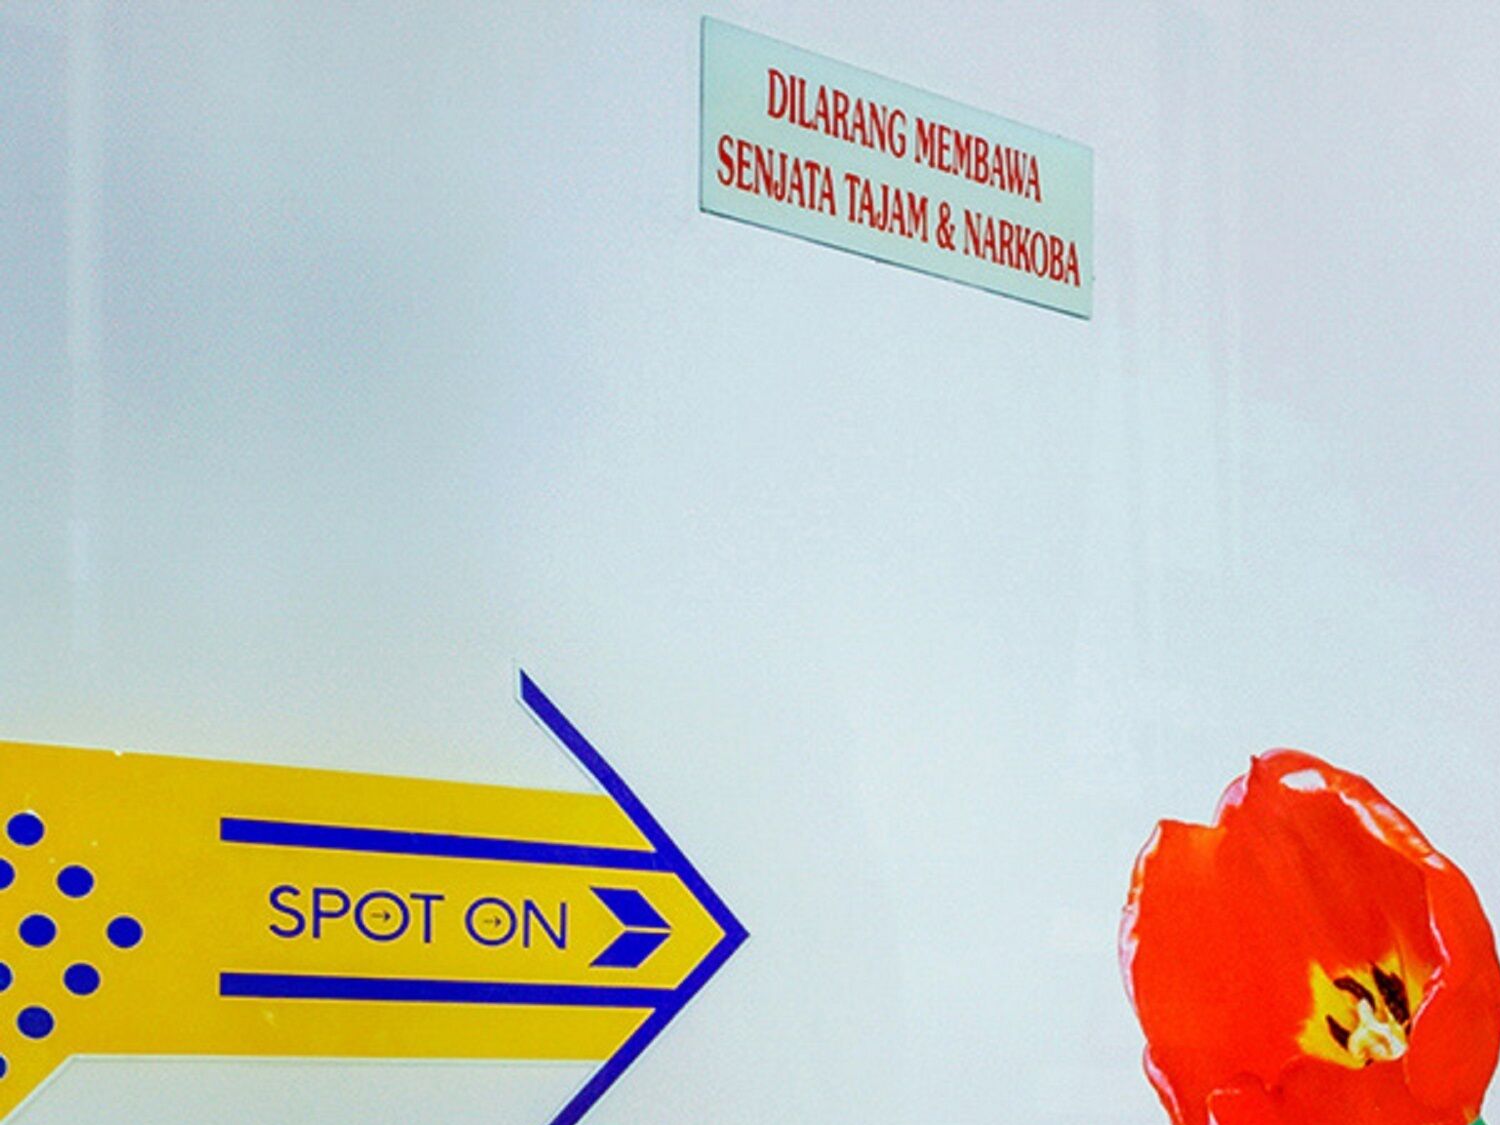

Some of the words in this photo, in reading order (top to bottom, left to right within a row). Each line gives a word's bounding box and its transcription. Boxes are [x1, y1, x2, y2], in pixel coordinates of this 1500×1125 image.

[767, 68, 907, 159] DILARANG
[914, 117, 1043, 204] MEMBAWA
[716, 134, 837, 217] SENJATA
[844, 172, 929, 243] TAJAM
[935, 201, 957, 251] &
[963, 208, 1082, 288] NARKOBA
[269, 884, 445, 945] SPOT
[465, 896, 568, 950] ON
